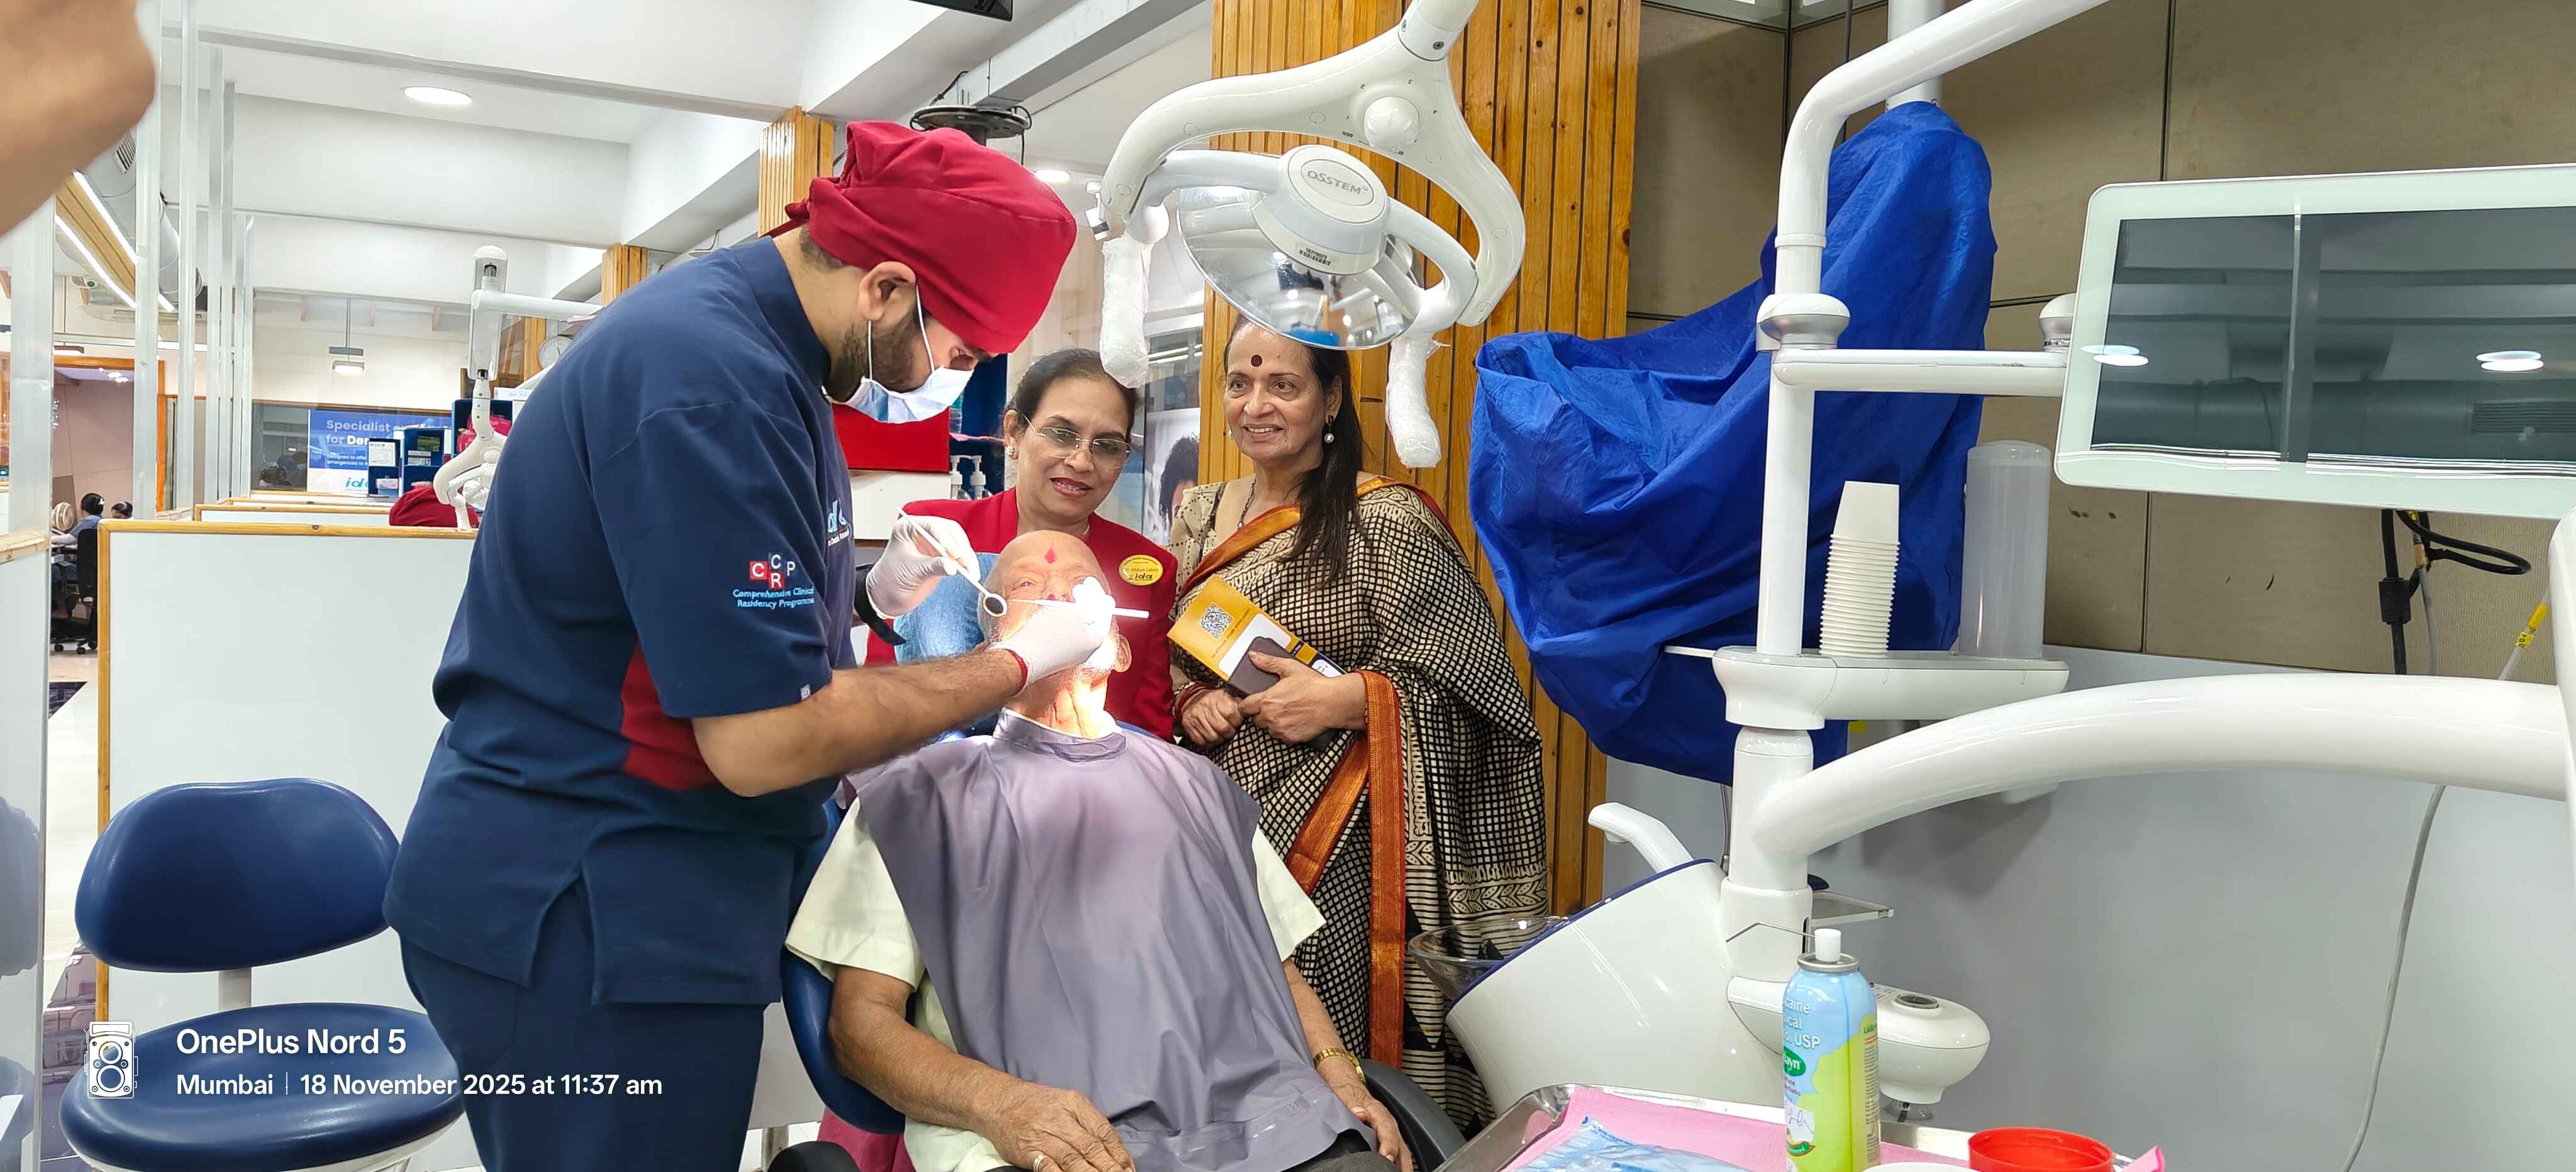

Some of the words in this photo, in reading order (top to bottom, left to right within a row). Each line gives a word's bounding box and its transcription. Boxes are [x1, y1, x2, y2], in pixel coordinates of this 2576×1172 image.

[326, 420, 391, 432] Specialist
[326, 434, 344, 444] for
[752, 563, 765, 577] C
[770, 554, 781, 569] C
[786, 561, 796, 576] P
[770, 572, 782, 589] R
[733, 589, 791, 599] Comprehensive
[737, 599, 777, 610] Residency
[1794, 1032, 1820, 1050] USP
